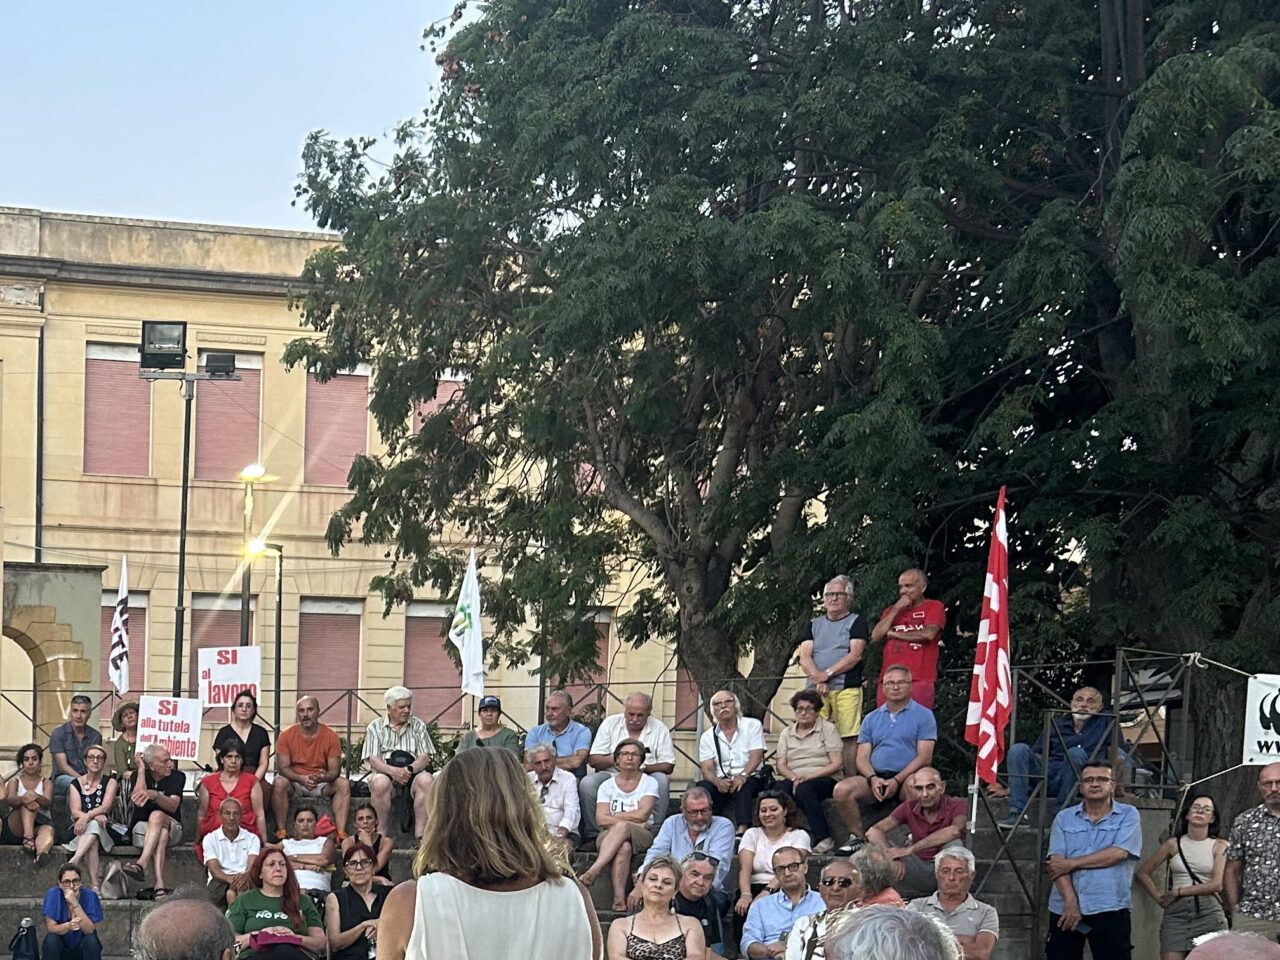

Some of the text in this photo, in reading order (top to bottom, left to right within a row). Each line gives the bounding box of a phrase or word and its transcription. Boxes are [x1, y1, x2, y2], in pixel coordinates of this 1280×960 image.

[216, 649, 238, 665] SI
[201, 668, 211, 680] al
[157, 700, 179, 716] Si
[140, 716, 190, 733] alla tutela
